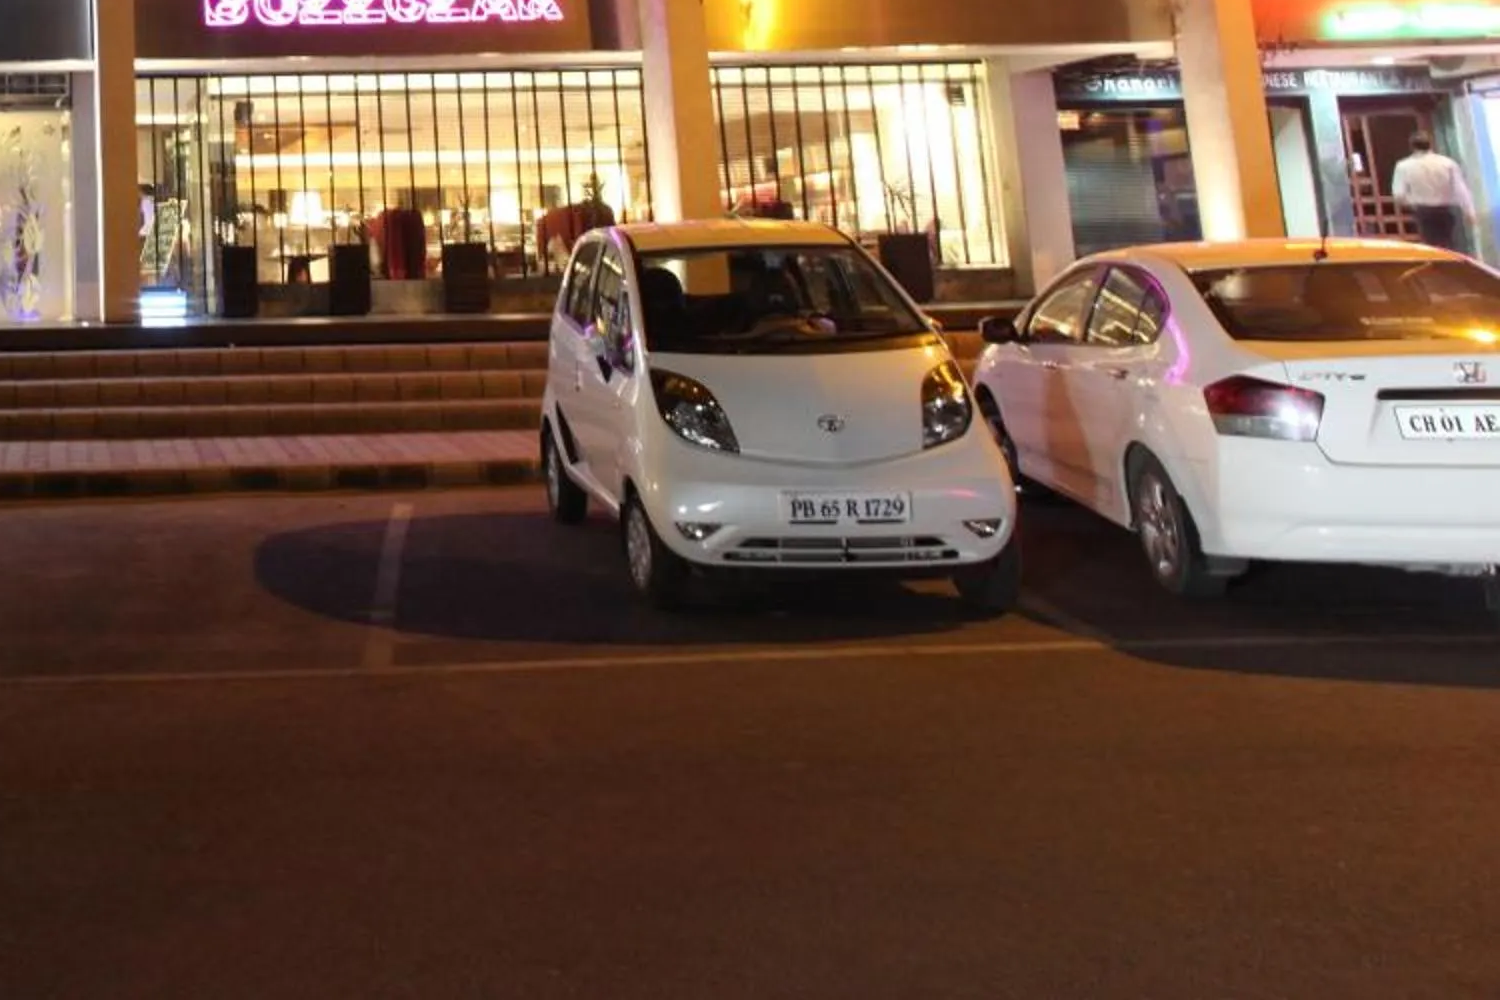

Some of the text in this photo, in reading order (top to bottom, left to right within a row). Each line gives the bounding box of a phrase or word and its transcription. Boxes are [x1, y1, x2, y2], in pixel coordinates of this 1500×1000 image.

[791, 497, 905, 519] PB 65 R 1729
